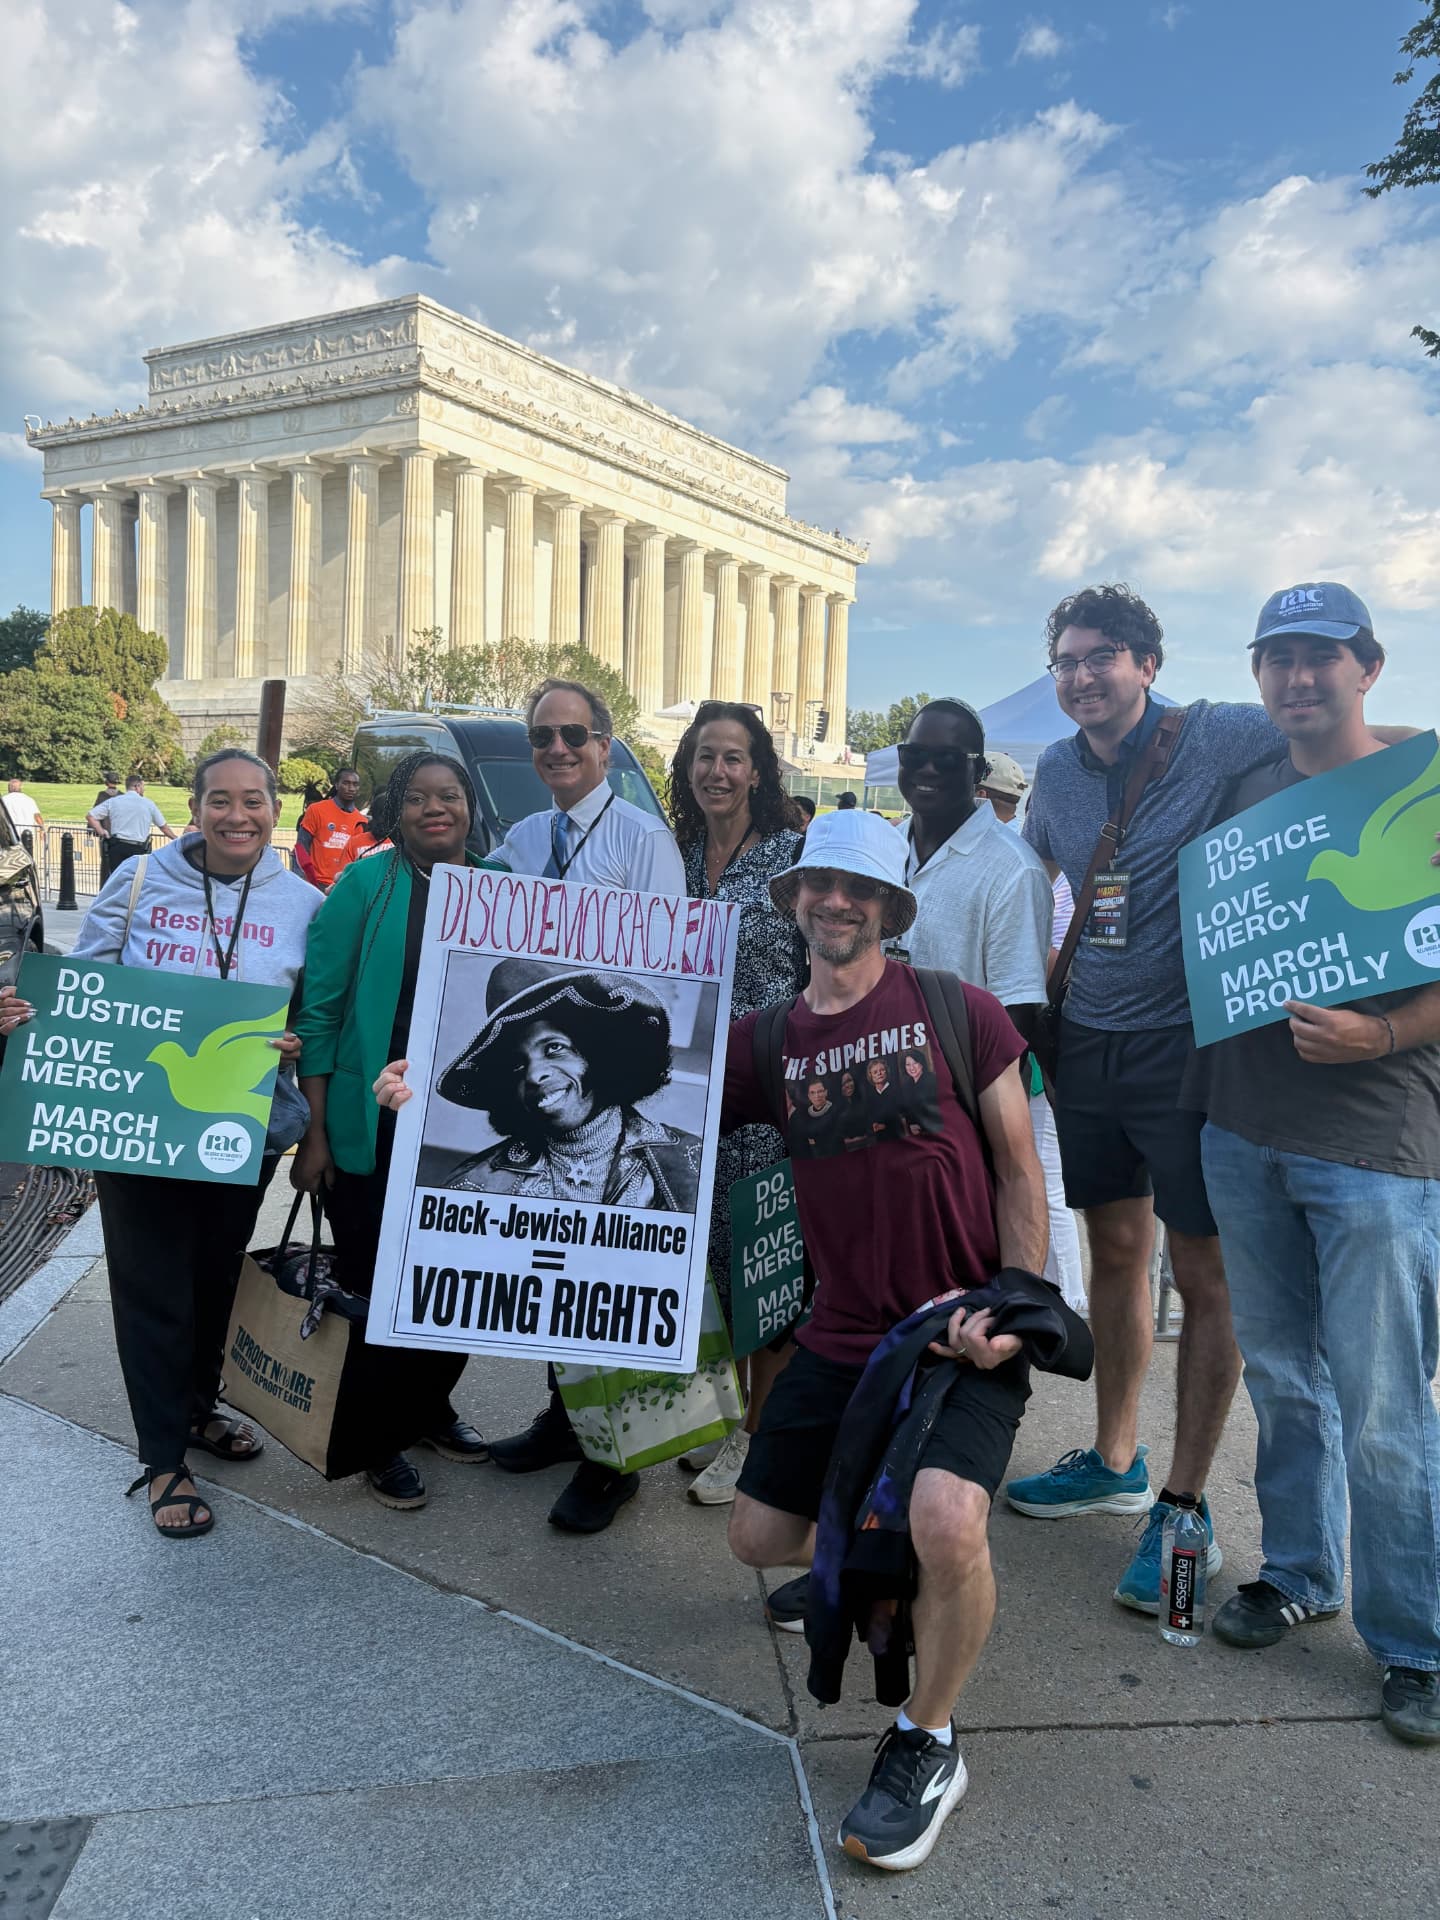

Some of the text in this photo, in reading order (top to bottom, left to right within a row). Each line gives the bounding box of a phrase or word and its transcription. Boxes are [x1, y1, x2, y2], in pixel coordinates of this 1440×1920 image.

[1205, 827, 1243, 864] DO
[1207, 814, 1331, 888] JUSTICE
[150, 906, 275, 948] Resistng
[1196, 881, 1273, 934] LOVE
[1199, 895, 1310, 960] MERCY
[57, 968, 105, 996] DO
[1221, 932, 1349, 996] MARCH
[1225, 950, 1390, 1024] PROUDLY
[50, 994, 184, 1032] JUSTICE
[26, 1032, 114, 1065] LOVE
[782, 1022, 927, 1081] HE SUPREMES
[21, 1058, 145, 1094] MERCY
[32, 1102, 159, 1138] MARCH
[27, 1128, 186, 1167] PROUDLY
[205, 1134, 245, 1153] rac
[756, 1172, 785, 1204] DO
[419, 1194, 687, 1255] Black-Jewish Alliance
[743, 1220, 796, 1267] LOVE
[411, 1264, 680, 1348] VOTING RIGHTS
[235, 1324, 273, 1375] TAPROOT
[251, 1368, 285, 1399] TAPROOT
[282, 1390, 311, 1413] EARTH
[1176, 1558, 1188, 1609] essentia
